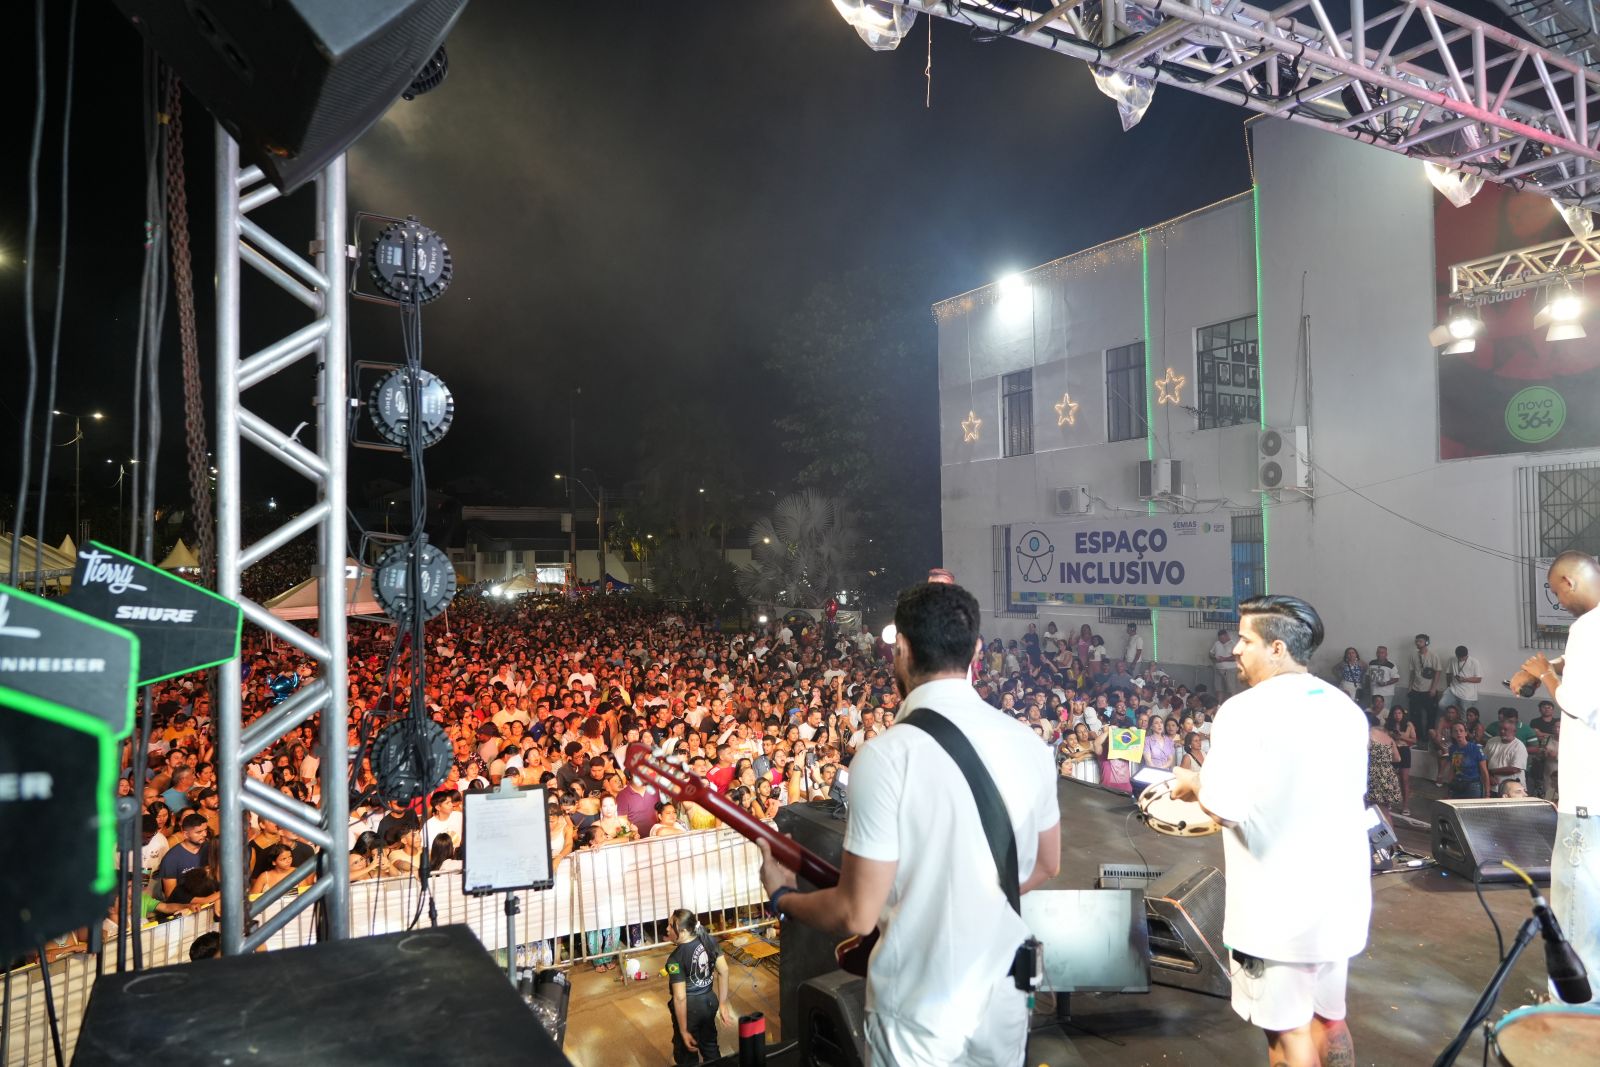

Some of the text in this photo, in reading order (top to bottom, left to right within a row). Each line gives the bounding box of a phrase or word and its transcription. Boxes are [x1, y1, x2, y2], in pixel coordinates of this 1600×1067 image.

[1517, 400, 1553, 411] nova
[1518, 410, 1553, 430] 364
[1075, 528, 1168, 560] ESPAÇO
[79, 550, 148, 594] Tierry
[1059, 560, 1185, 585] INCLUSIVO
[115, 605, 198, 623] SHURE
